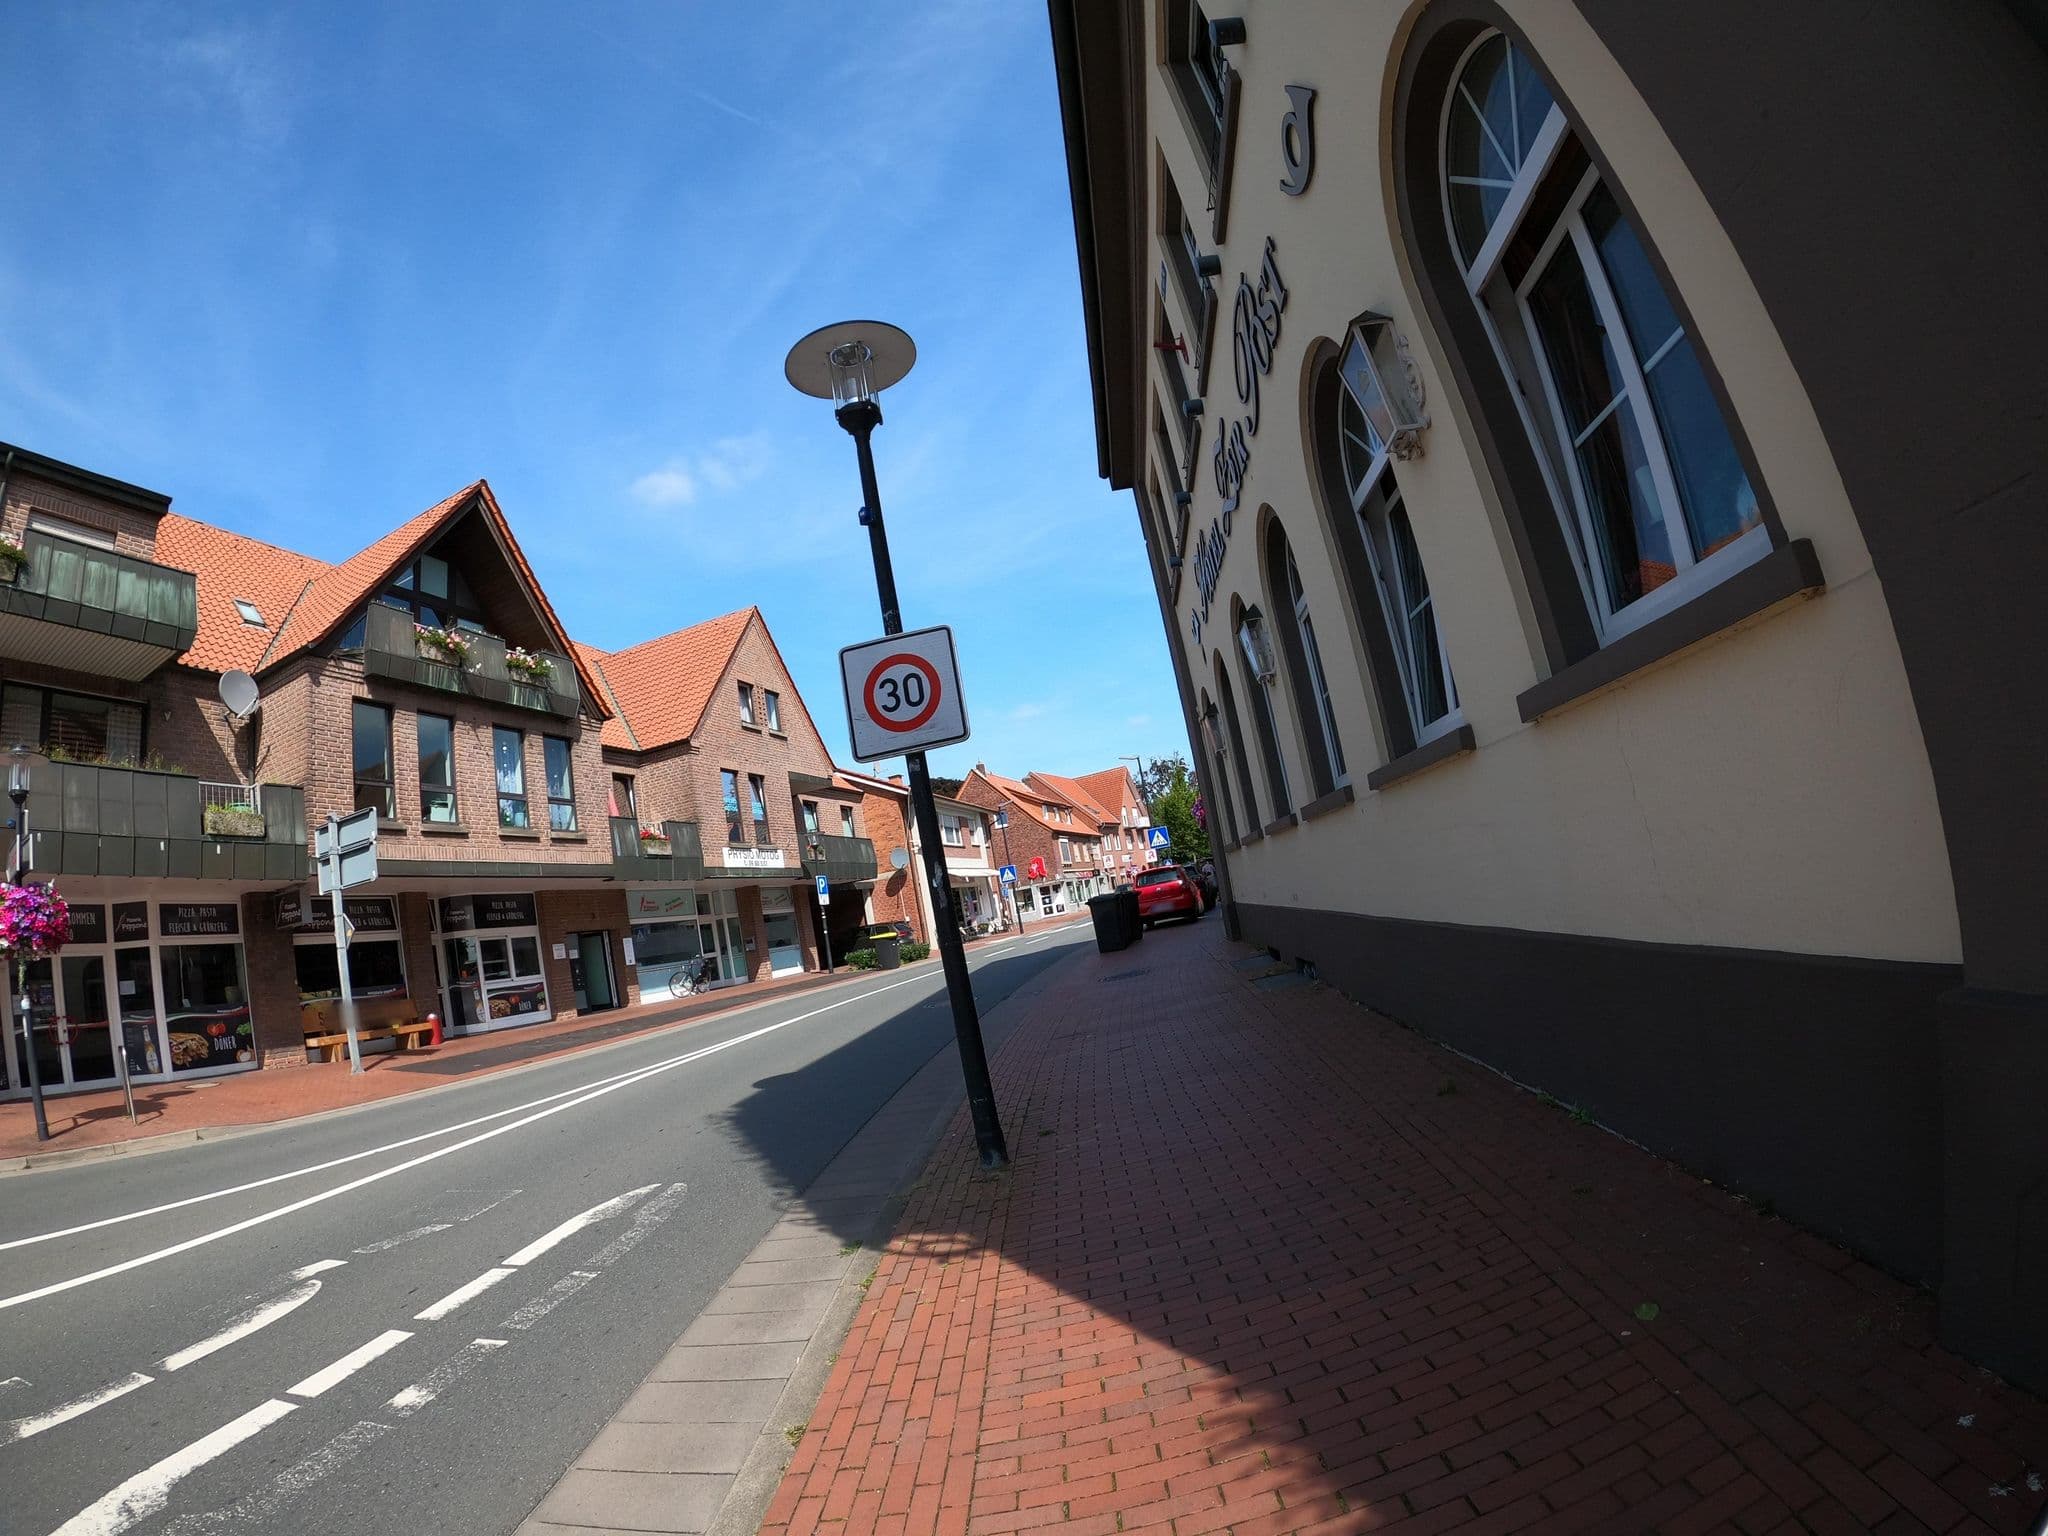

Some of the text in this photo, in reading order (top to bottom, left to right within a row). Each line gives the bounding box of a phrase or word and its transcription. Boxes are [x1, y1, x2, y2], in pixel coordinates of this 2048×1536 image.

[878, 672, 925, 713] 30
[819, 878, 826, 894] P
[178, 906, 217, 917] PIZZA PASTA
[214, 1035, 237, 1051] DÖNER
